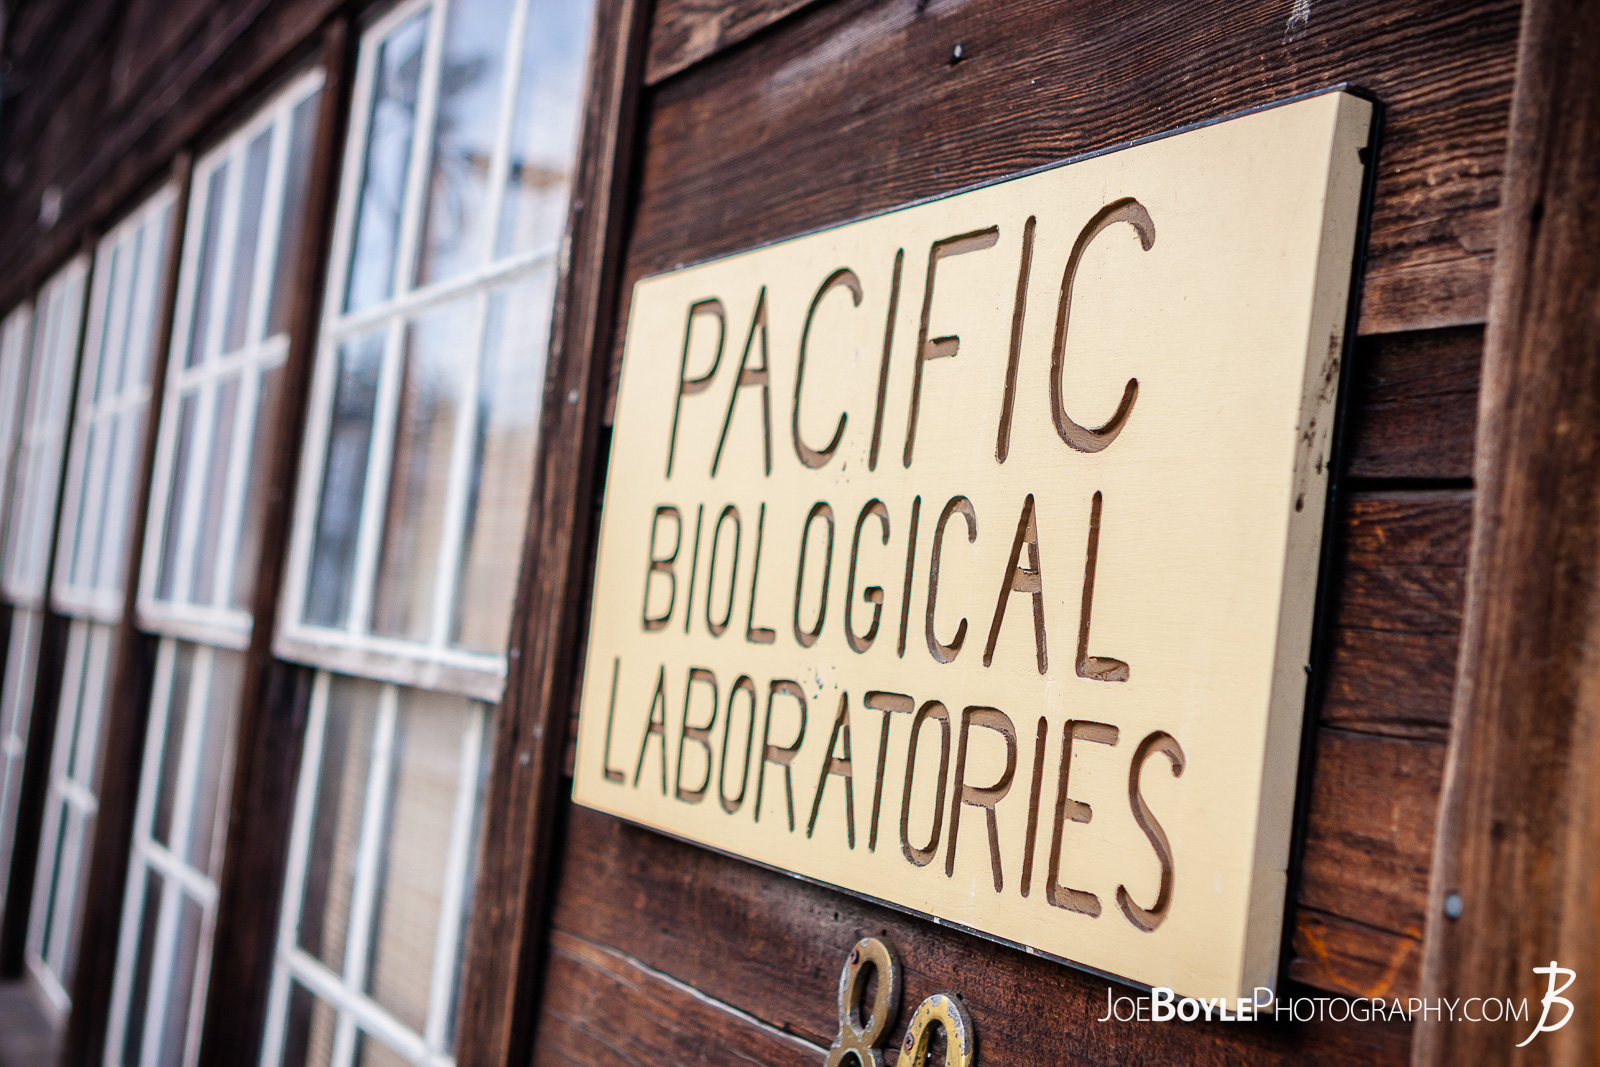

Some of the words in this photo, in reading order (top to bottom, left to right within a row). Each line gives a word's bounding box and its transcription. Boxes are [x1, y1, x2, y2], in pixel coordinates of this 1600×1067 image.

[666, 197, 1156, 480] PACIFIC
[642, 490, 1130, 682] BIOLOGICAL
[603, 656, 1186, 933] LABORATORIES
